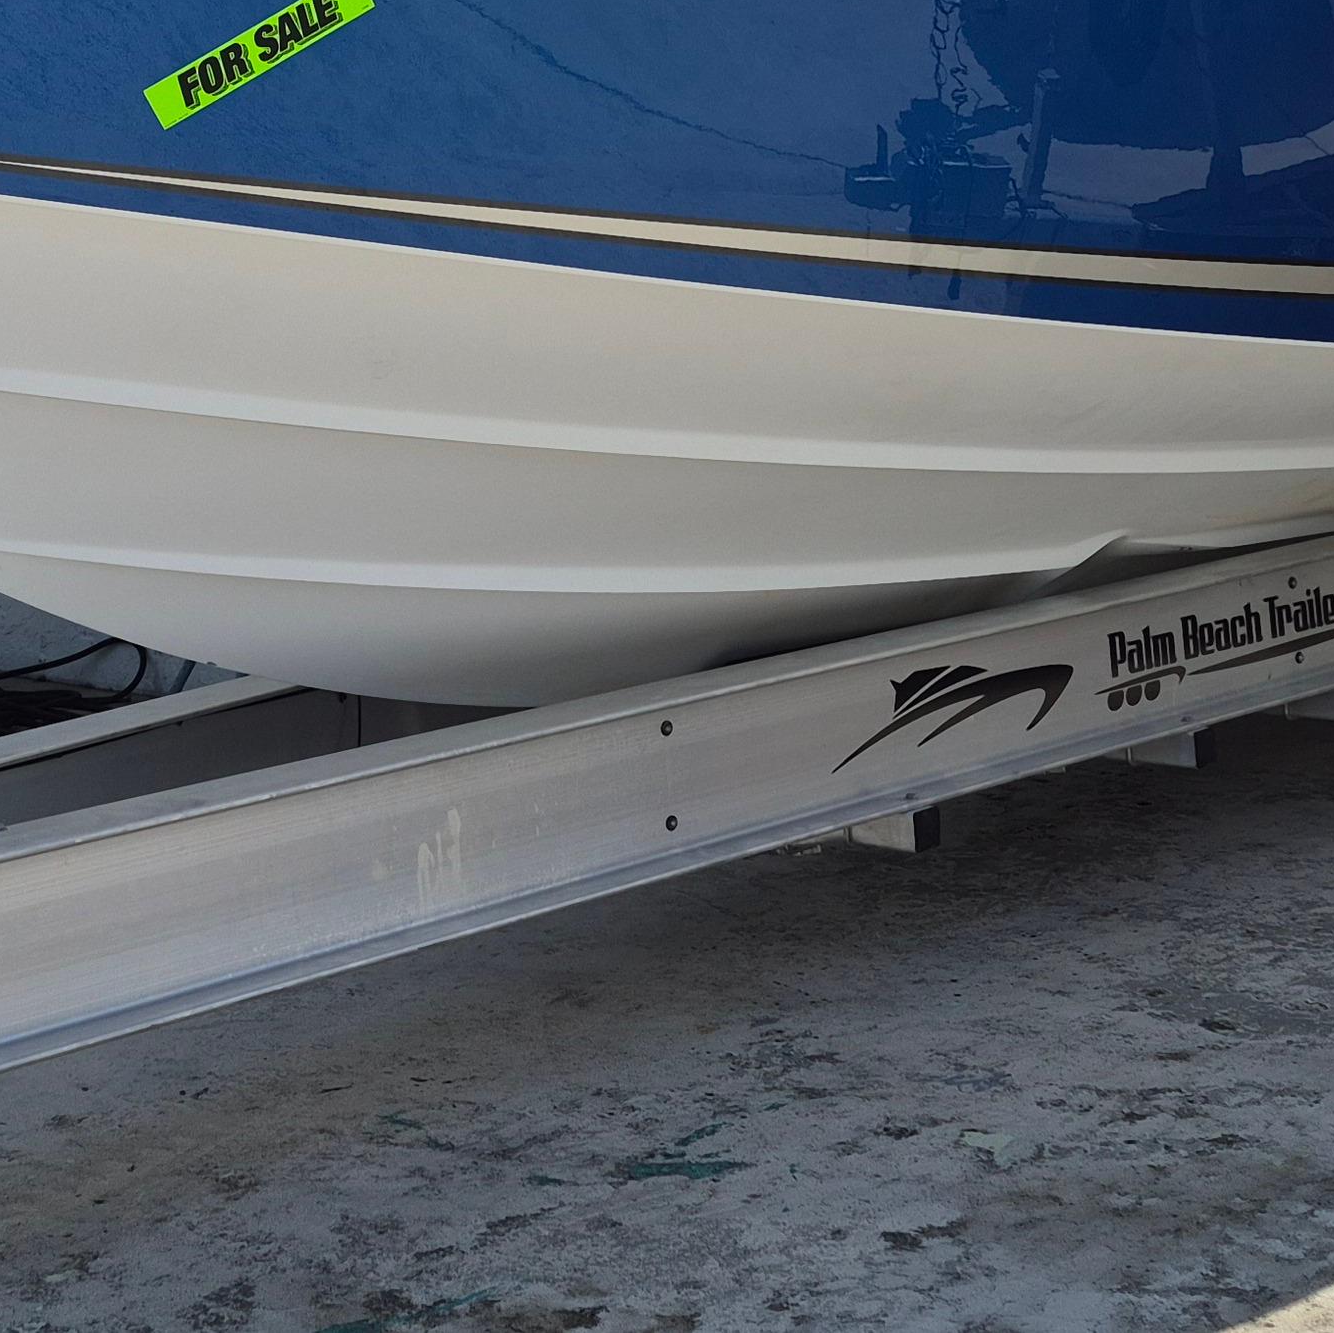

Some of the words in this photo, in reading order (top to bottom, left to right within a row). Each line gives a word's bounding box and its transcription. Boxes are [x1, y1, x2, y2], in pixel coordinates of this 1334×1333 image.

[177, 42, 255, 110] FOR
[1107, 625, 1178, 678] Palm
[1180, 602, 1263, 660] Beach
